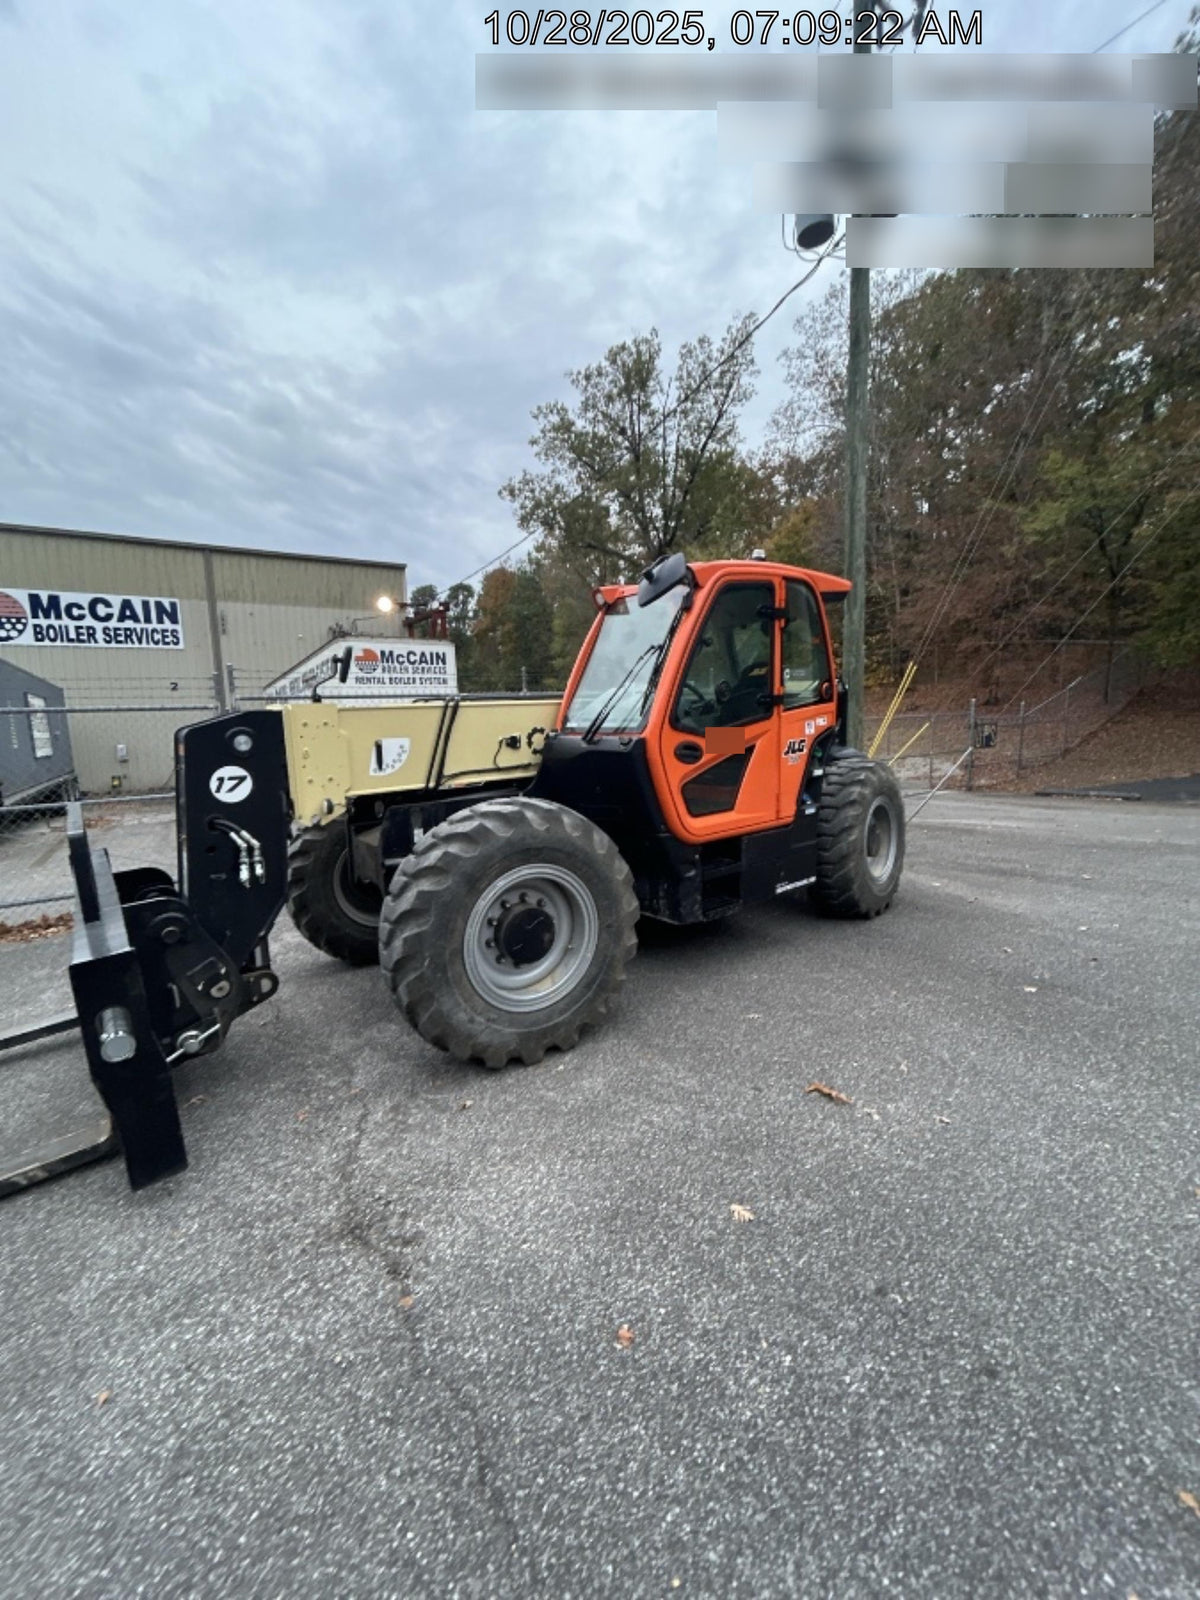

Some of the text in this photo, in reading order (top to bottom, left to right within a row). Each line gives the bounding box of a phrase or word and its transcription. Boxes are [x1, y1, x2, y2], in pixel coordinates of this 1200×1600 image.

[28, 593, 179, 625] McCAIN
[33, 624, 180, 646] BOILER SERVICES
[380, 650, 447, 666] McCAIN
[411, 665, 447, 675] SERVICES
[170, 682, 178, 691] 2
[355, 676, 386, 685] RENTAL
[389, 676, 417, 685] BOILER
[783, 739, 806, 756] JLG
[214, 775, 248, 793] 17
